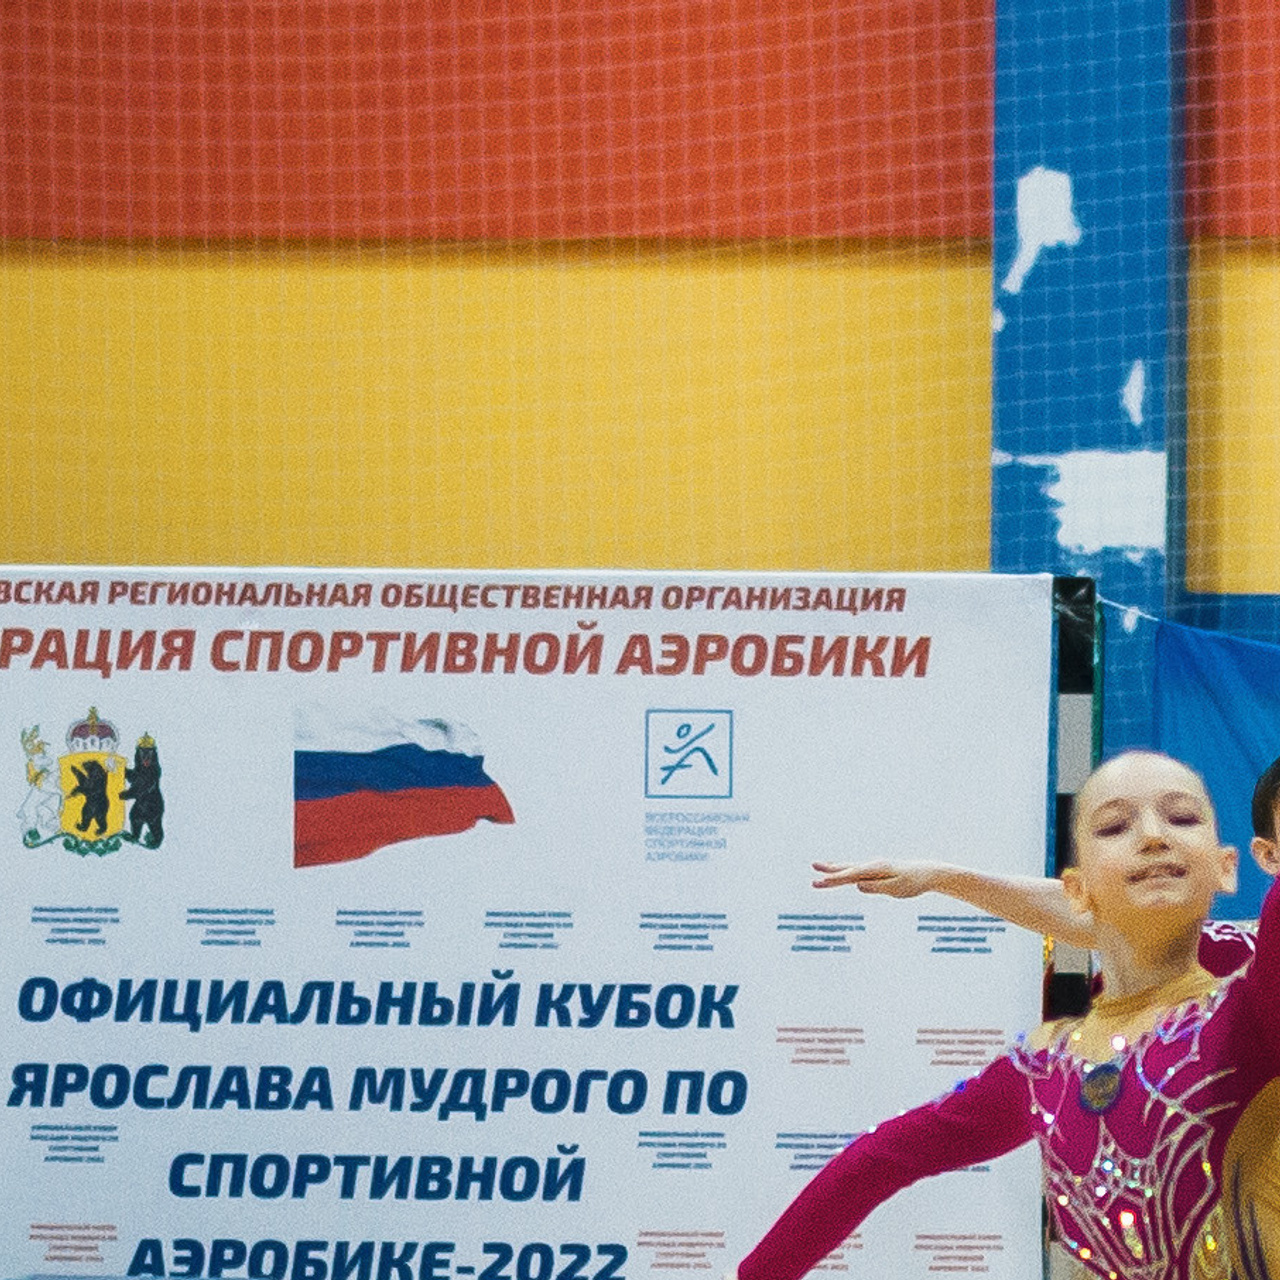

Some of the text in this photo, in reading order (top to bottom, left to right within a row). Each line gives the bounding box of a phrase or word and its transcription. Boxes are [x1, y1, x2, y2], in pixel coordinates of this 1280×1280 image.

[108, 581, 373, 607] РЕГИОНАЛЬНАЯ
[381, 584, 654, 613] ОБЩЕСТВЕННАЯ
[661, 586, 906, 616] ОРГАНИЗАЦИЯ
[0, 620, 931, 679] РАЦИЯ СПОРТИВНОЙ АЭРОБИКИ
[17, 969, 740, 1033] ОФИЦИАЛЬНЫЙ КУБОК
[6, 1062, 749, 1122] ЯРОСЛАВА МУДРОГО ПО
[168, 1143, 586, 1202] СПОРТИВНОЙ
